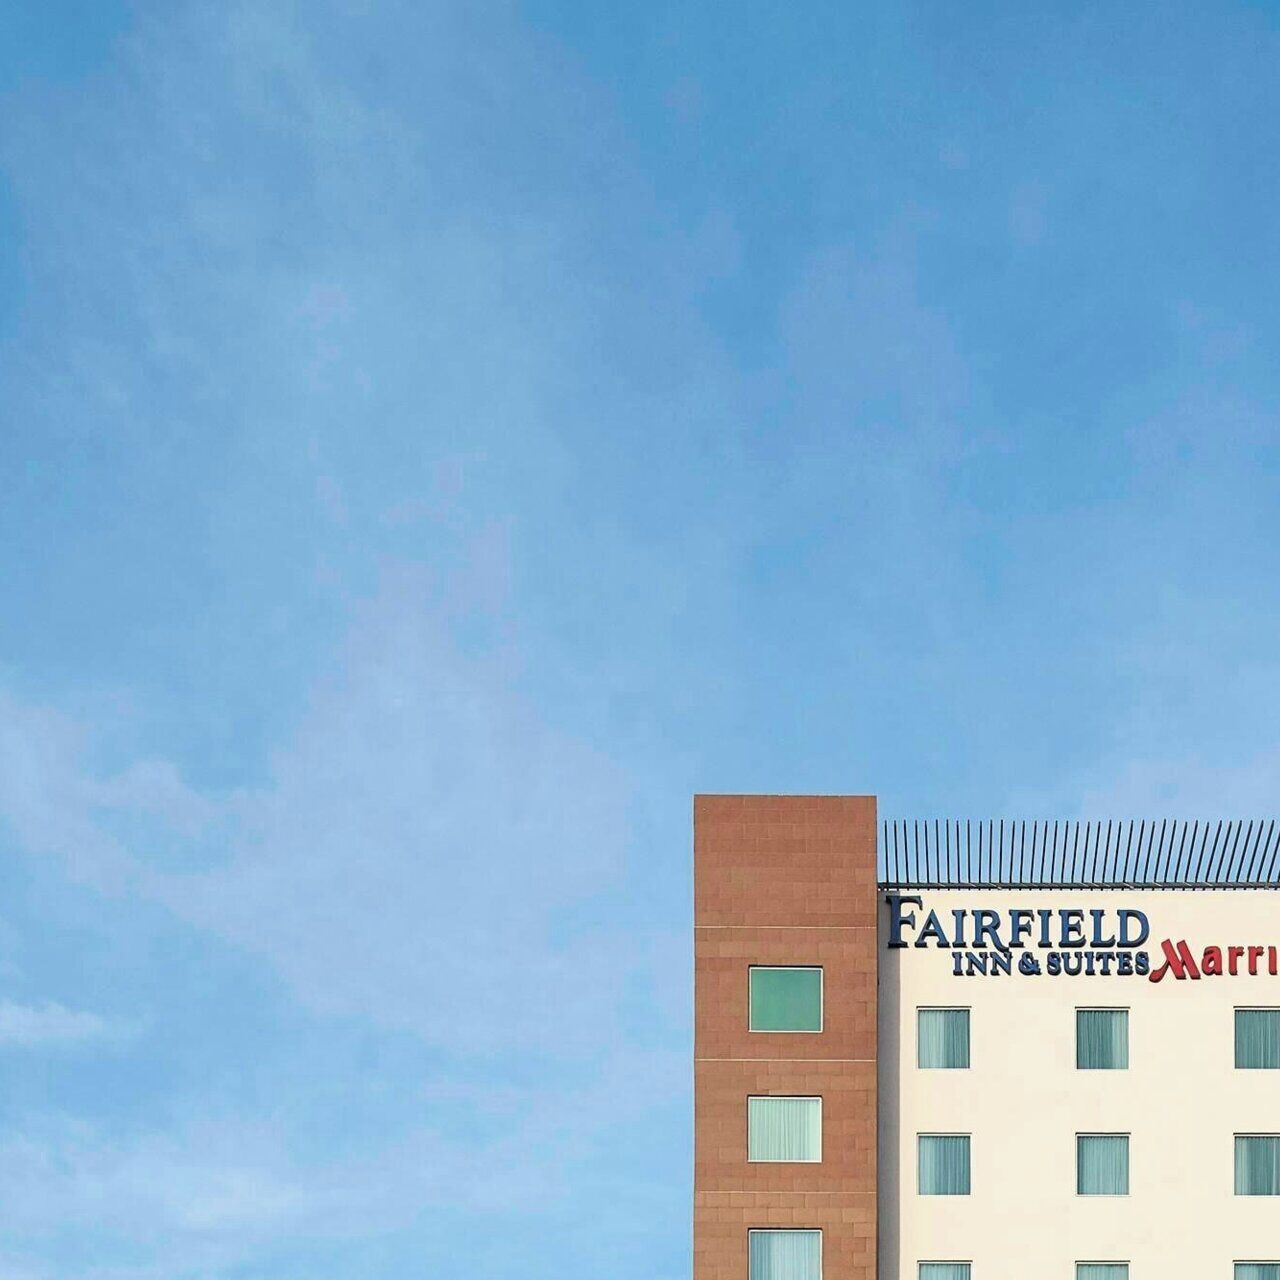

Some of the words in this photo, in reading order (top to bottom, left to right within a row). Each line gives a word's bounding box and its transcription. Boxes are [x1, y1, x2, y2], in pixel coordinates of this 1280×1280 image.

[886, 895, 1150, 953] FAIRFIELD
[952, 951, 1013, 976] INN
[1017, 951, 1042, 976] &
[1047, 951, 1150, 977] SUITES
